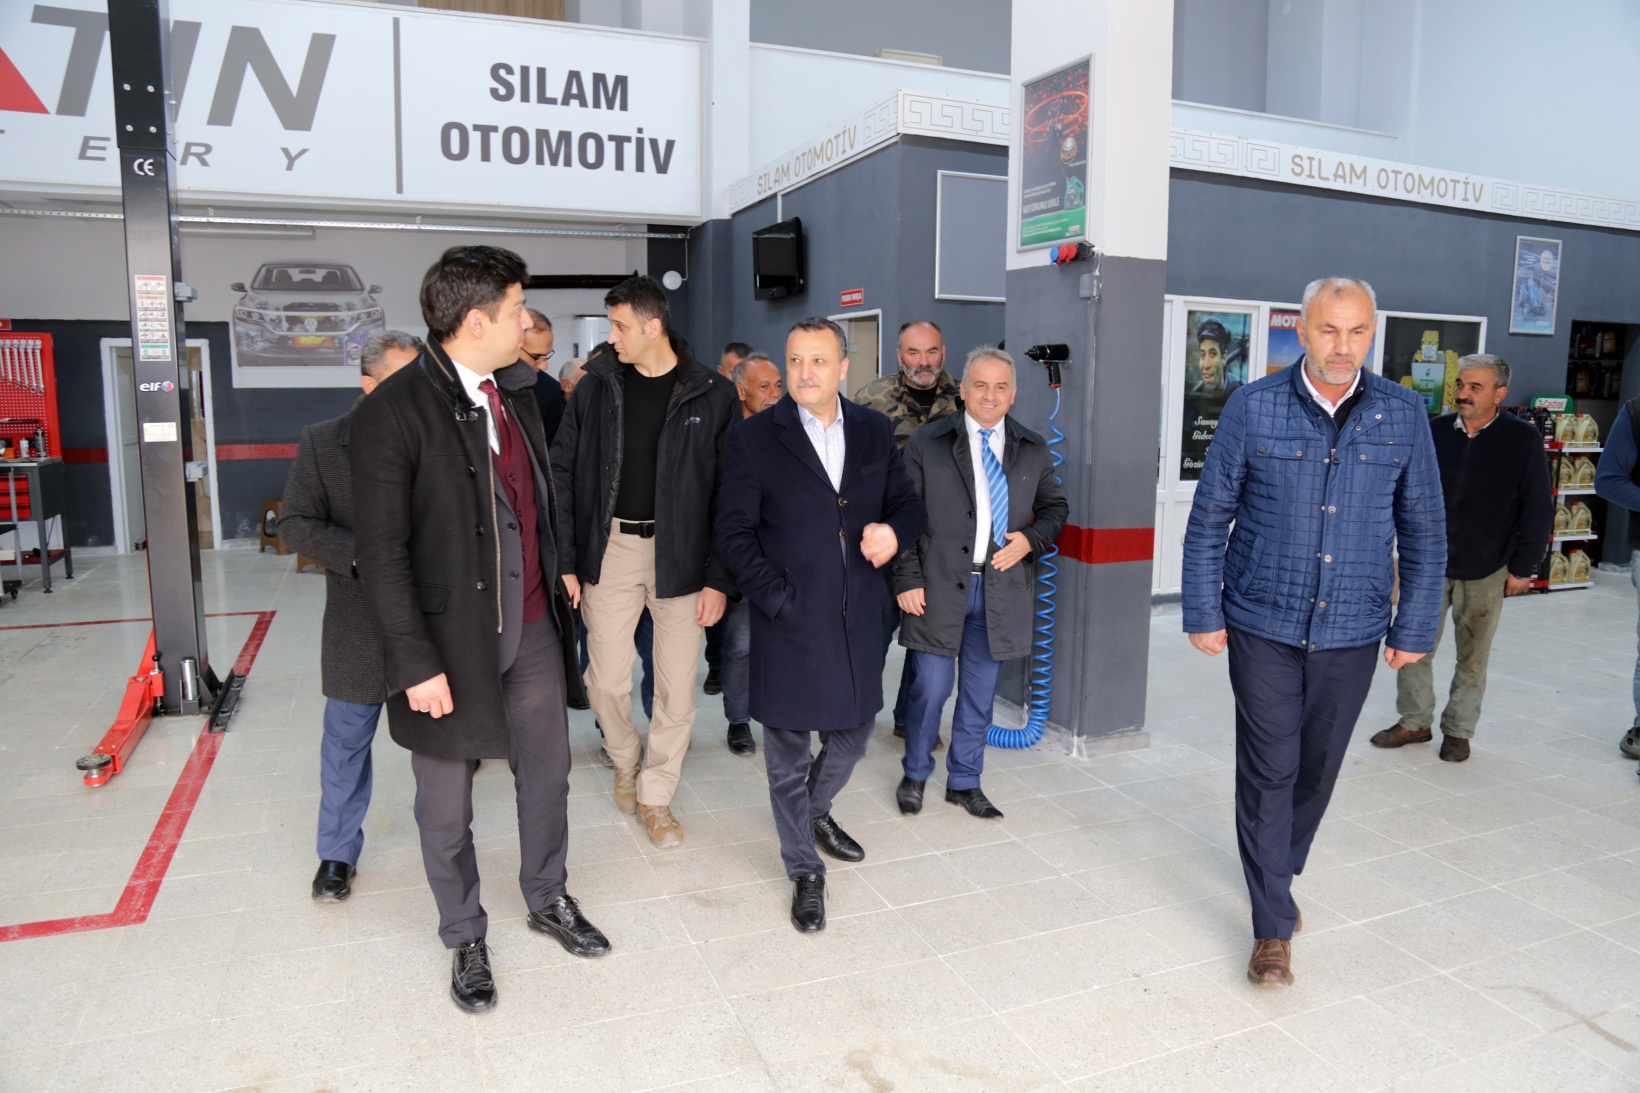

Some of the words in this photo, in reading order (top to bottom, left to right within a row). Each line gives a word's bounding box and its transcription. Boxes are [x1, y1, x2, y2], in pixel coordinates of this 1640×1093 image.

[489, 62, 628, 112] SILAM
[440, 121, 676, 175] OTOMOTİV
[757, 160, 790, 195] SILAM
[794, 124, 857, 178] OTOMOTİV
[1291, 154, 1367, 187] SILAM
[1377, 167, 1484, 204] OTOMOTİV
[139, 382, 161, 392] elf
[1542, 399, 1565, 410] Castrol
